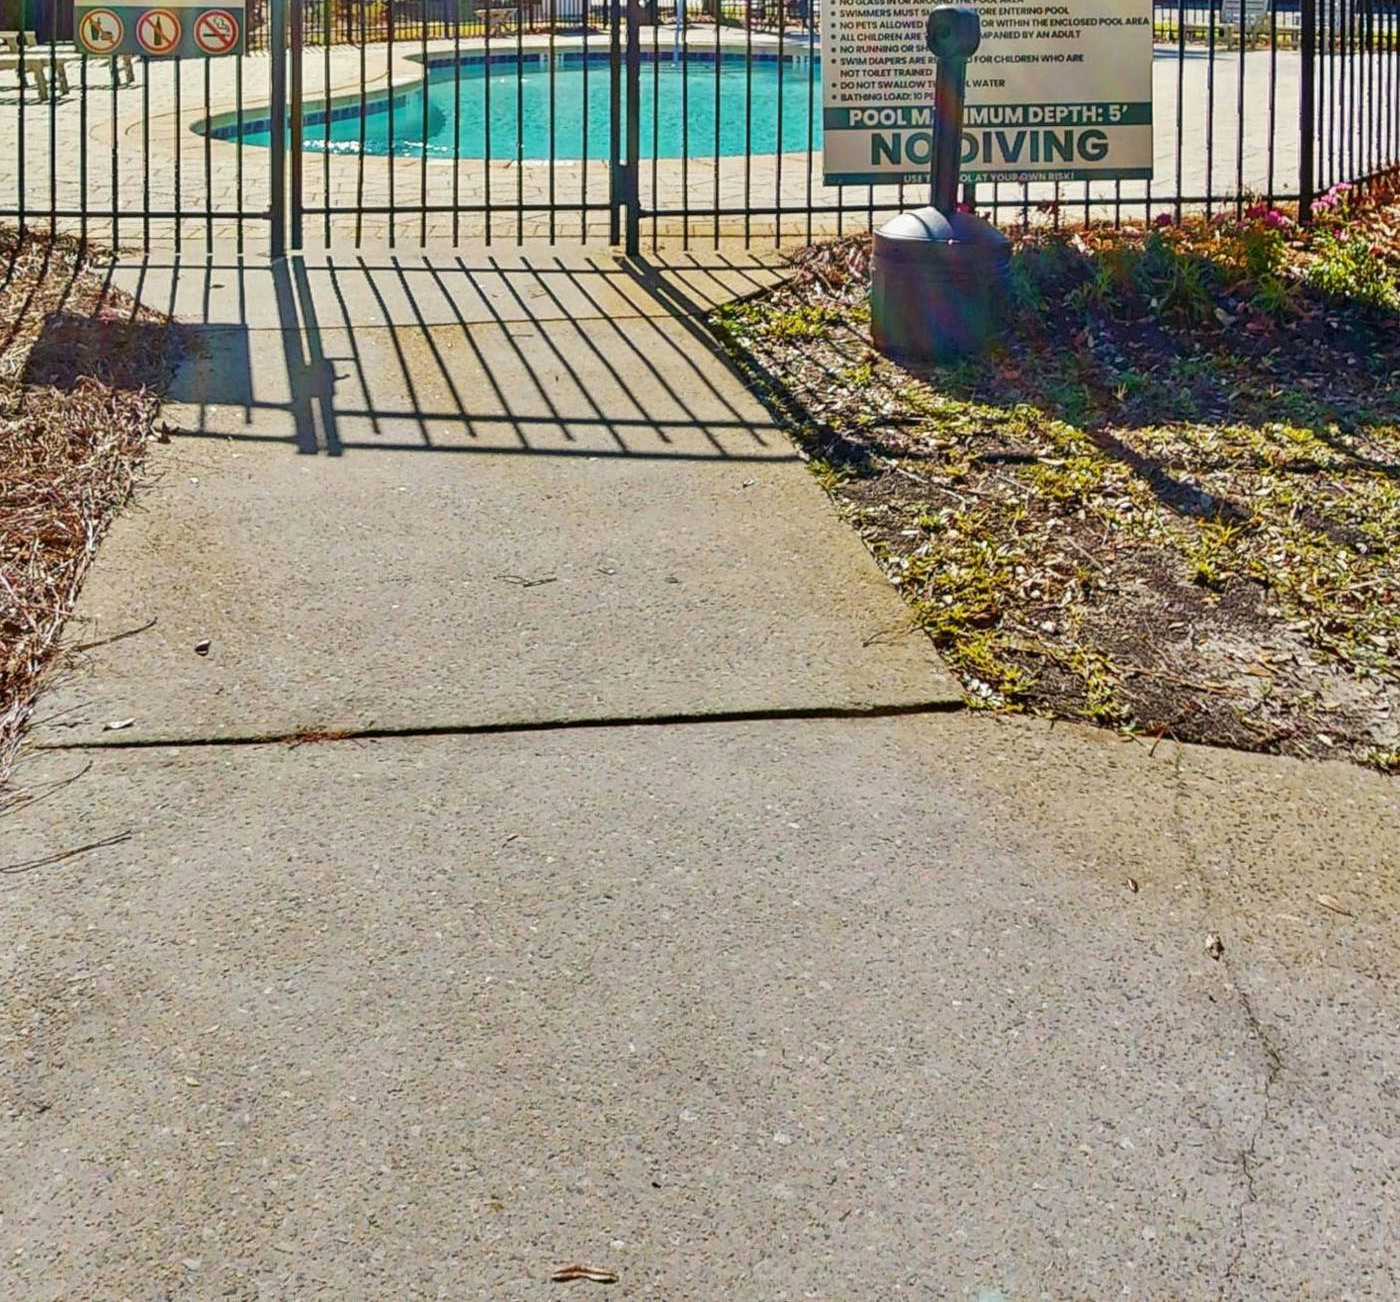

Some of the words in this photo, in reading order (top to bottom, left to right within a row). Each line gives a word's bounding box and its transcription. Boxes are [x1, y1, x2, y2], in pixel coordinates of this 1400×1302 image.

[840, 10, 892, 18] SWIMMERS
[894, 9, 919, 17] MUST
[1000, 7, 1042, 15] ENTERING
[840, 21, 854, 30] NO
[856, 21, 878, 29] PETS
[879, 21, 924, 29] ALLOWED
[996, 19, 1030, 27] WITHIN
[1032, 19, 1048, 27] THE
[1050, 18, 1097, 26] ENCLOSED
[1098, 18, 1124, 26] POOL
[1126, 17, 1150, 25] AREA
[840, 34, 855, 42] ALL
[857, 33, 902, 41] CHILDREN
[904, 33, 921, 41] ARE
[980, 31, 1021, 39] MPANIED
[1022, 31, 1035, 39] BY
[1036, 30, 1050, 39] AN
[1051, 30, 1081, 38] ADULT
[840, 46, 854, 54] NO
[856, 46, 900, 54] RUNNING
[900, 45, 915, 53] OR
[840, 58, 867, 66] SWIM
[868, 58, 907, 66] DIAPERS
[910, 57, 926, 65] ARE
[974, 56, 993, 64] FOR
[994, 55, 1040, 63] CHILDREN
[1041, 54, 1064, 63] WHO
[1066, 54, 1085, 62] ARE
[840, 70, 861, 78] NOT
[894, 69, 933, 77] TRAINED
[840, 82, 855, 90] DO
[856, 82, 877, 90] NOT
[878, 81, 927, 89] SWALLOW
[972, 80, 1005, 88] WATER
[840, 94, 883, 102] BATHING
[884, 93, 911, 101] LOAD:
[912, 92, 923, 100] 10
[849, 109, 907, 126] POOL
[911, 106, 1024, 126] MIMUM
[1028, 105, 1103, 124] DEPTH:
[1109, 104, 1128, 122] 5'
[871, 132, 934, 166] NO
[957, 128, 1109, 165] DIVING
[904, 175, 920, 183] USE
[976, 174, 988, 182] AT
[990, 173, 1018, 182] YOUR
